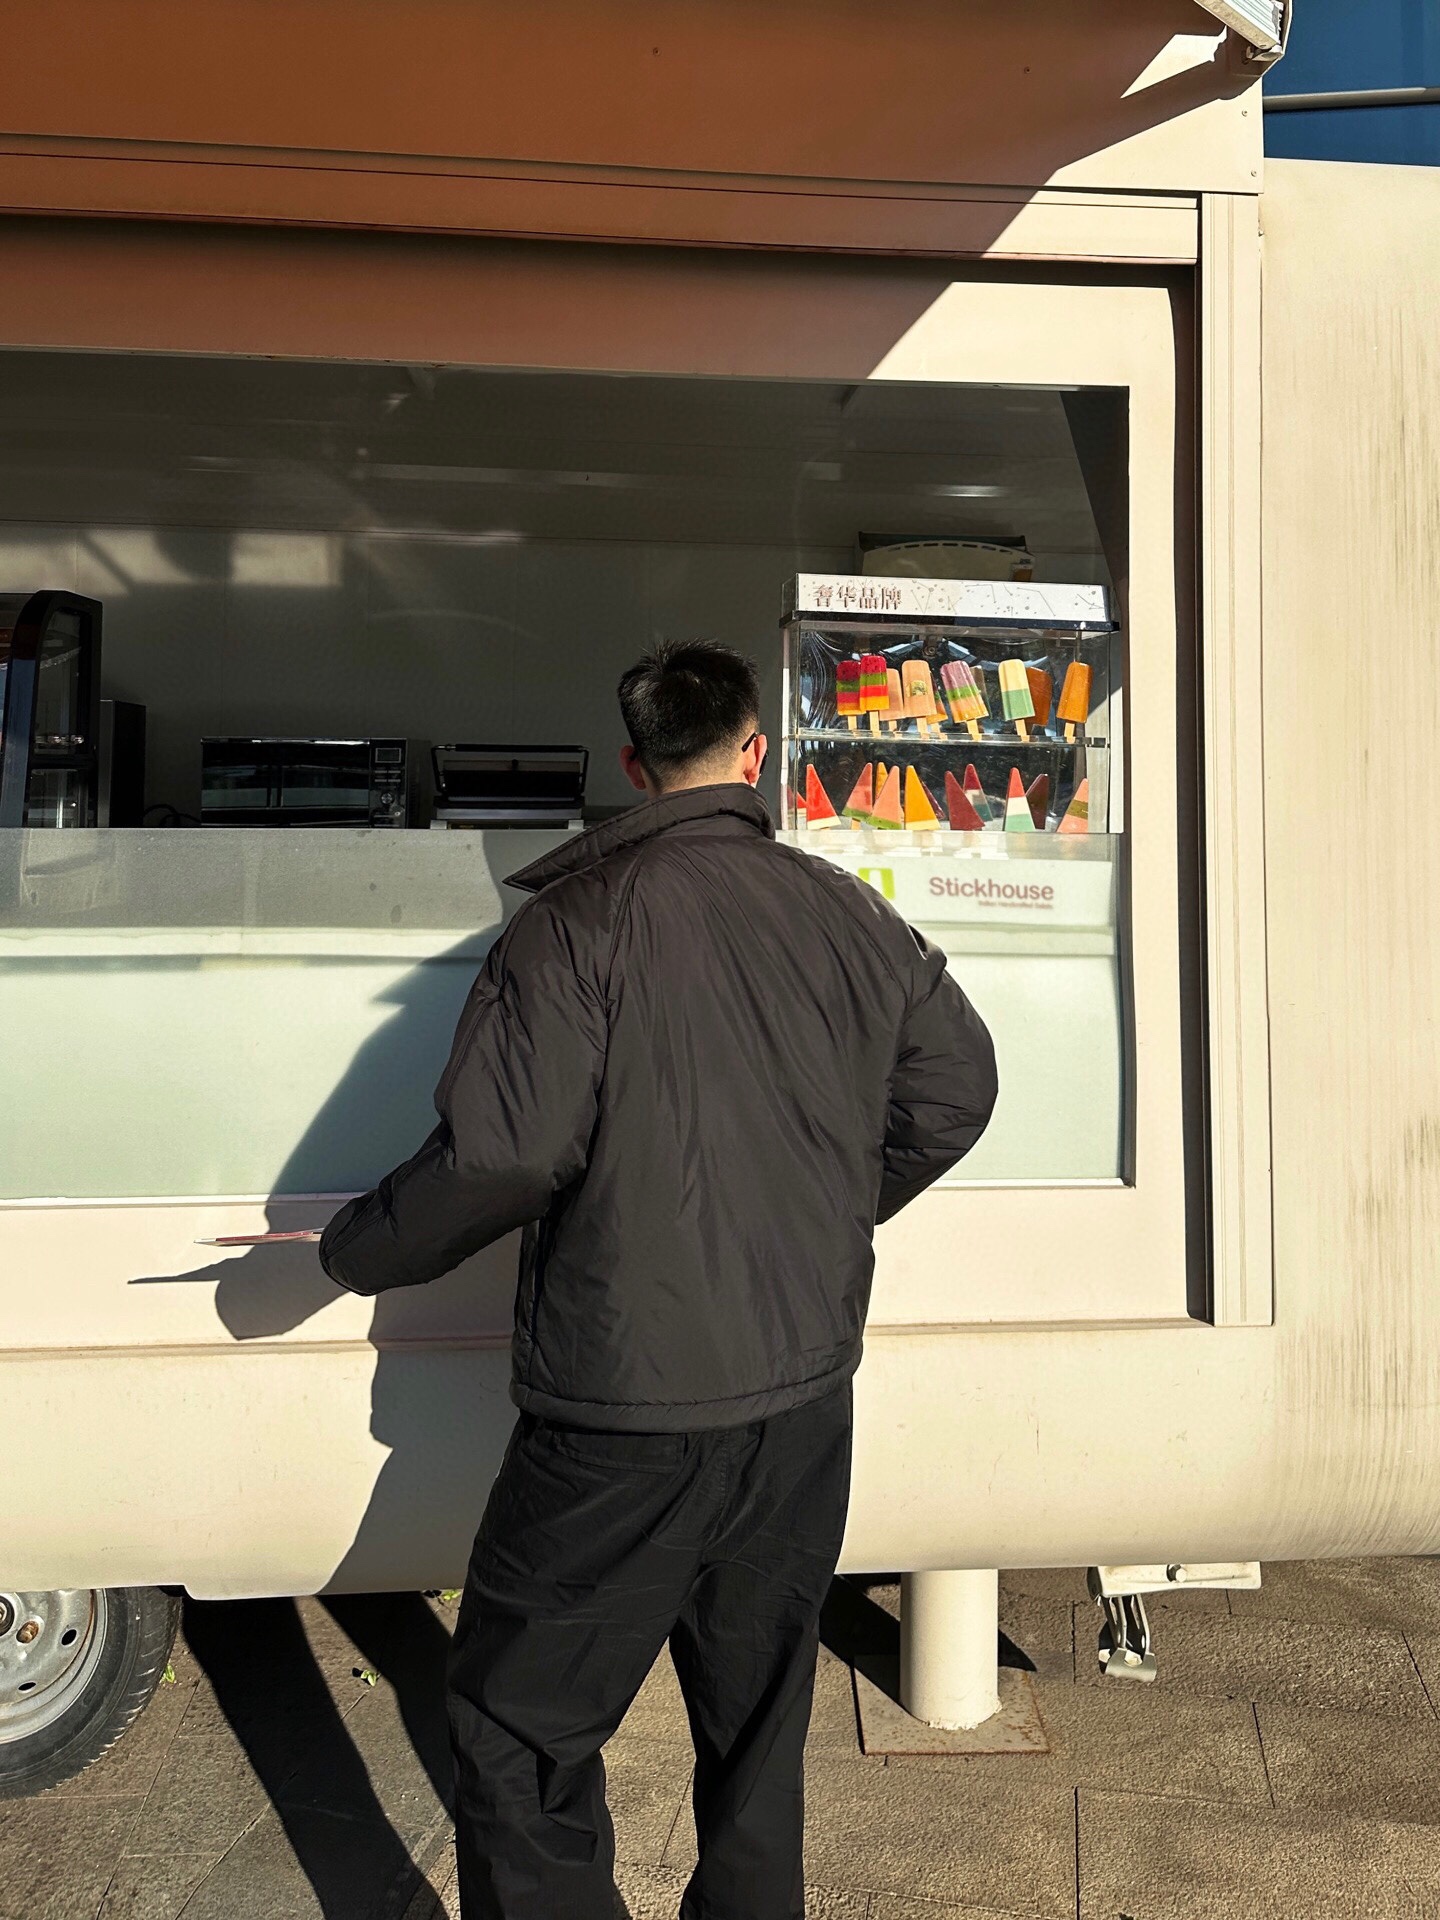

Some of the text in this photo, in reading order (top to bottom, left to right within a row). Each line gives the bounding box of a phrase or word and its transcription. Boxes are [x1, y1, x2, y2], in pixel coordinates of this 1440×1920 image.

[812, 584, 902, 610] 奢华品牌
[929, 876, 1054, 901] Stickhouse
